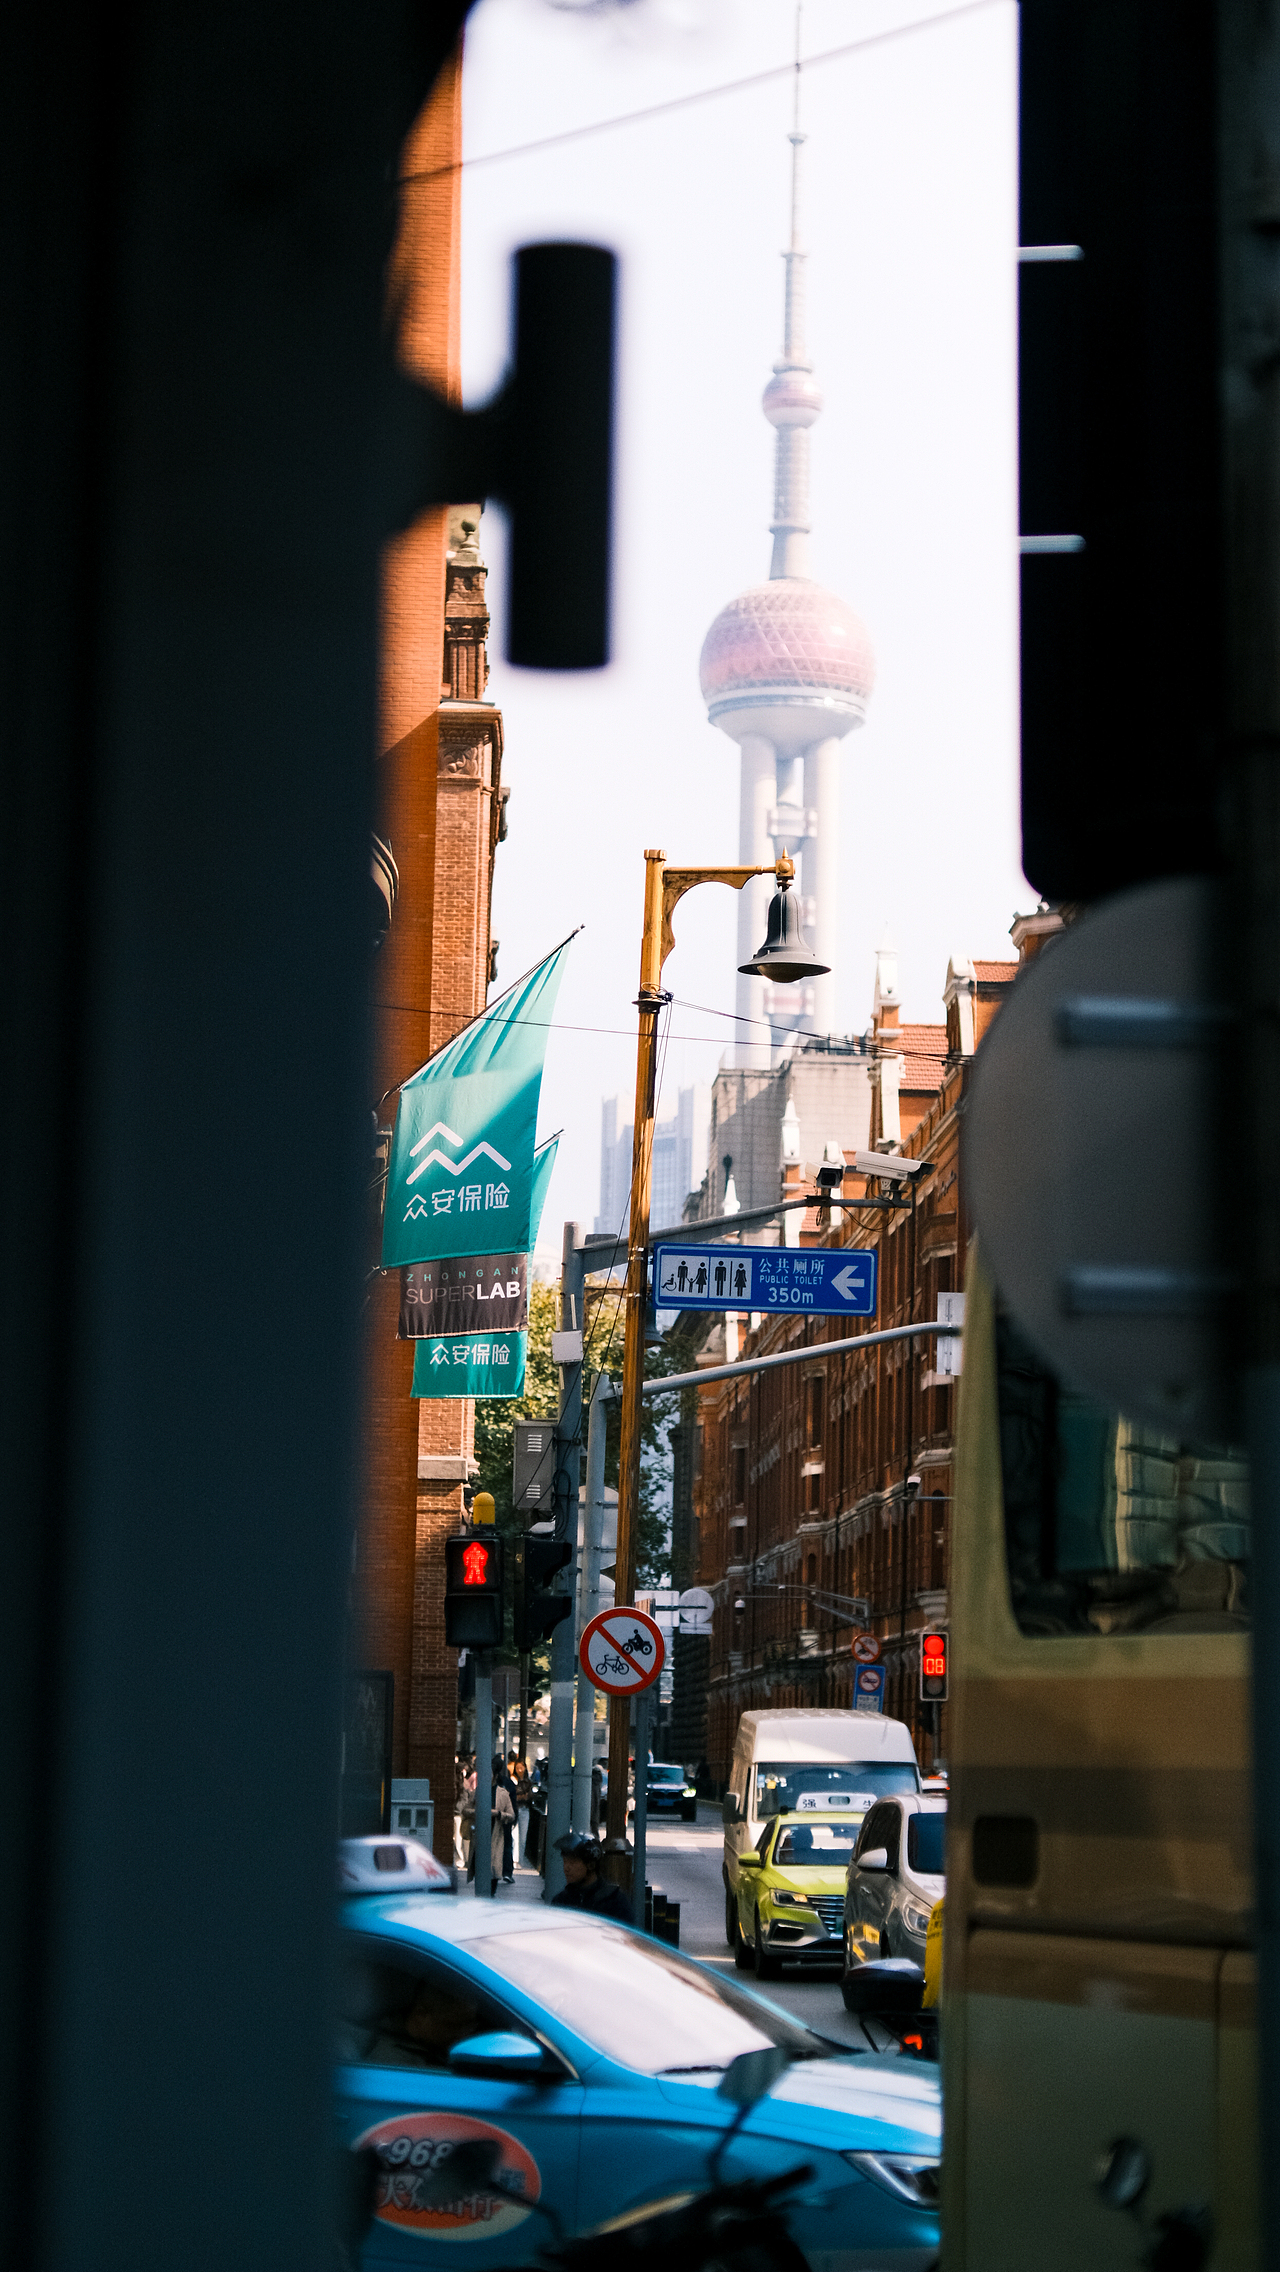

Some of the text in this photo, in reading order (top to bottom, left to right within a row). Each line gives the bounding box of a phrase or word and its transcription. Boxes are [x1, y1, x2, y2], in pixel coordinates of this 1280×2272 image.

[402, 1180, 510, 1222] 众安保险
[758, 1257, 826, 1276] 公共厕所
[759, 1275, 823, 1286] PUBLIC TOILET
[406, 1280, 521, 1306] SUPERLAB
[767, 1286, 814, 1304] 350m
[429, 1342, 511, 1366] 众安保险
[926, 1658, 944, 1674] 08
